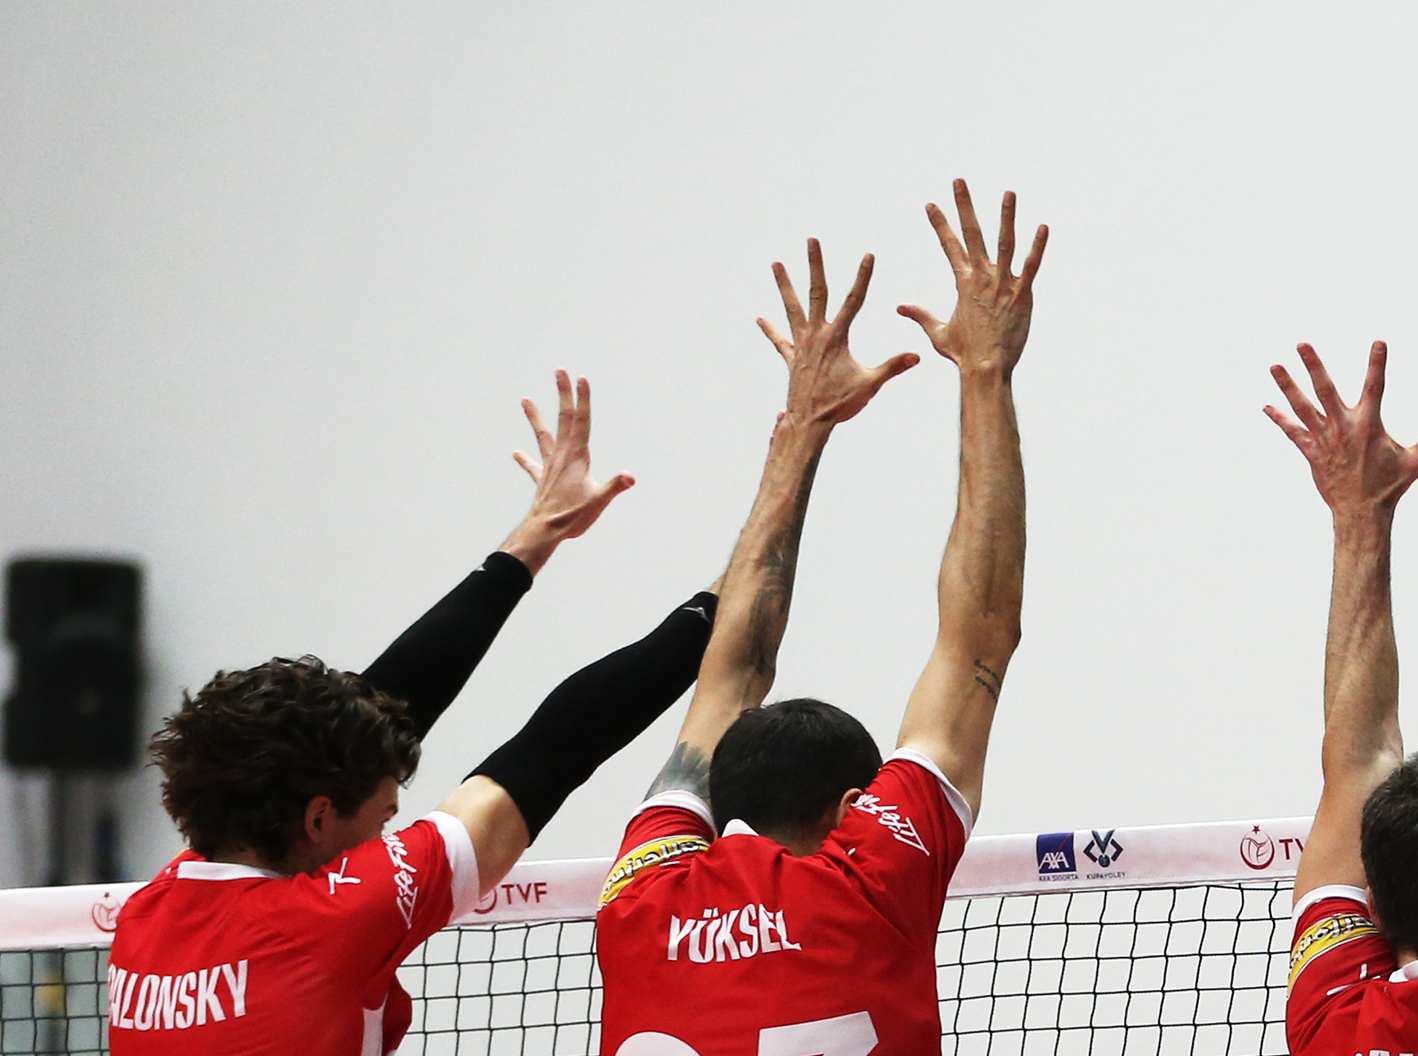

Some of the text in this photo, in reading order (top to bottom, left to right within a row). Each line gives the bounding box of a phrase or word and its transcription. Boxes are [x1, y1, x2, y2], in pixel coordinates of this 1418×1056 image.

[1038, 851, 1070, 870] AXA
[501, 882, 548, 903] TVF
[667, 903, 802, 963] YÜKSEL
